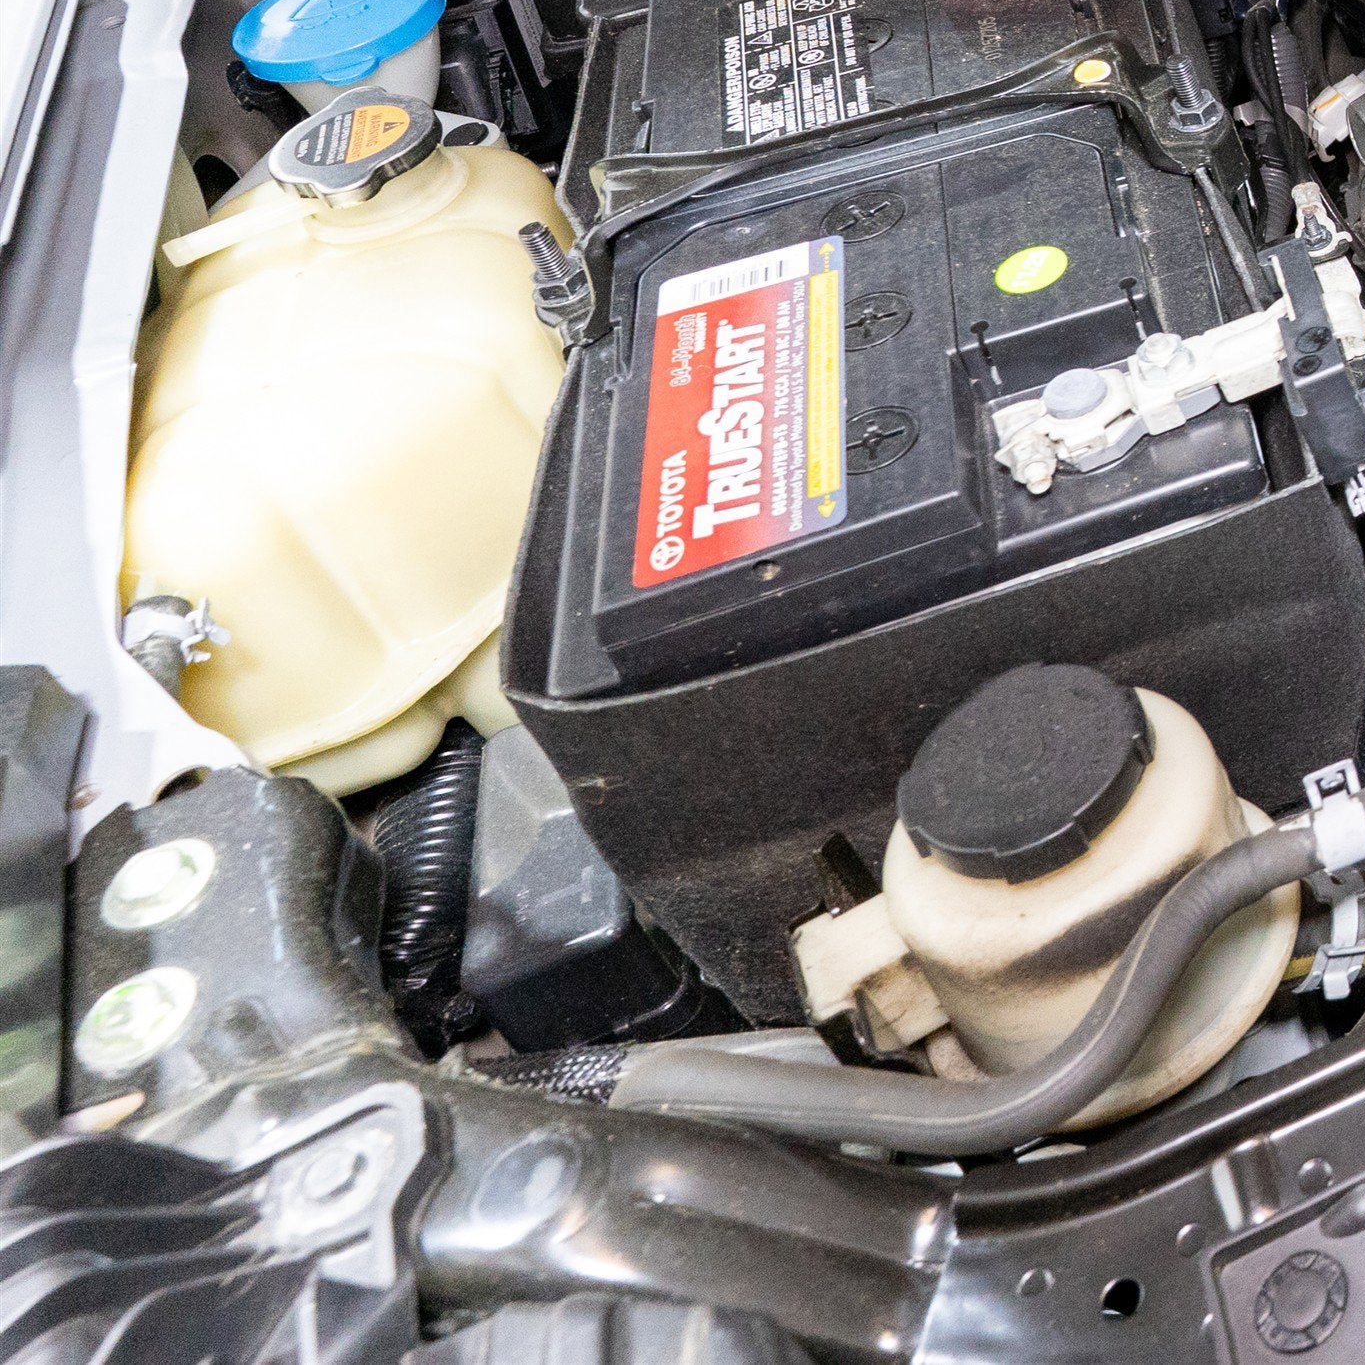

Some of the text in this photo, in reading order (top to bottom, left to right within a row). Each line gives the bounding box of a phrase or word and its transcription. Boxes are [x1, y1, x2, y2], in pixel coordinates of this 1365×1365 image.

[351, 110, 367, 157] AVERTISSEMENT
[368, 114, 381, 147] WARNING
[791, 301, 805, 323] Texas
[790, 321, 805, 347] Plano,
[668, 311, 692, 389] 84-Month
[774, 373, 789, 398] CCA
[789, 392, 804, 416] Sales
[789, 413, 804, 441] Motor
[788, 439, 803, 470] Toyota
[655, 447, 688, 539] TOYOTA
[787, 479, 803, 532] Distributed
